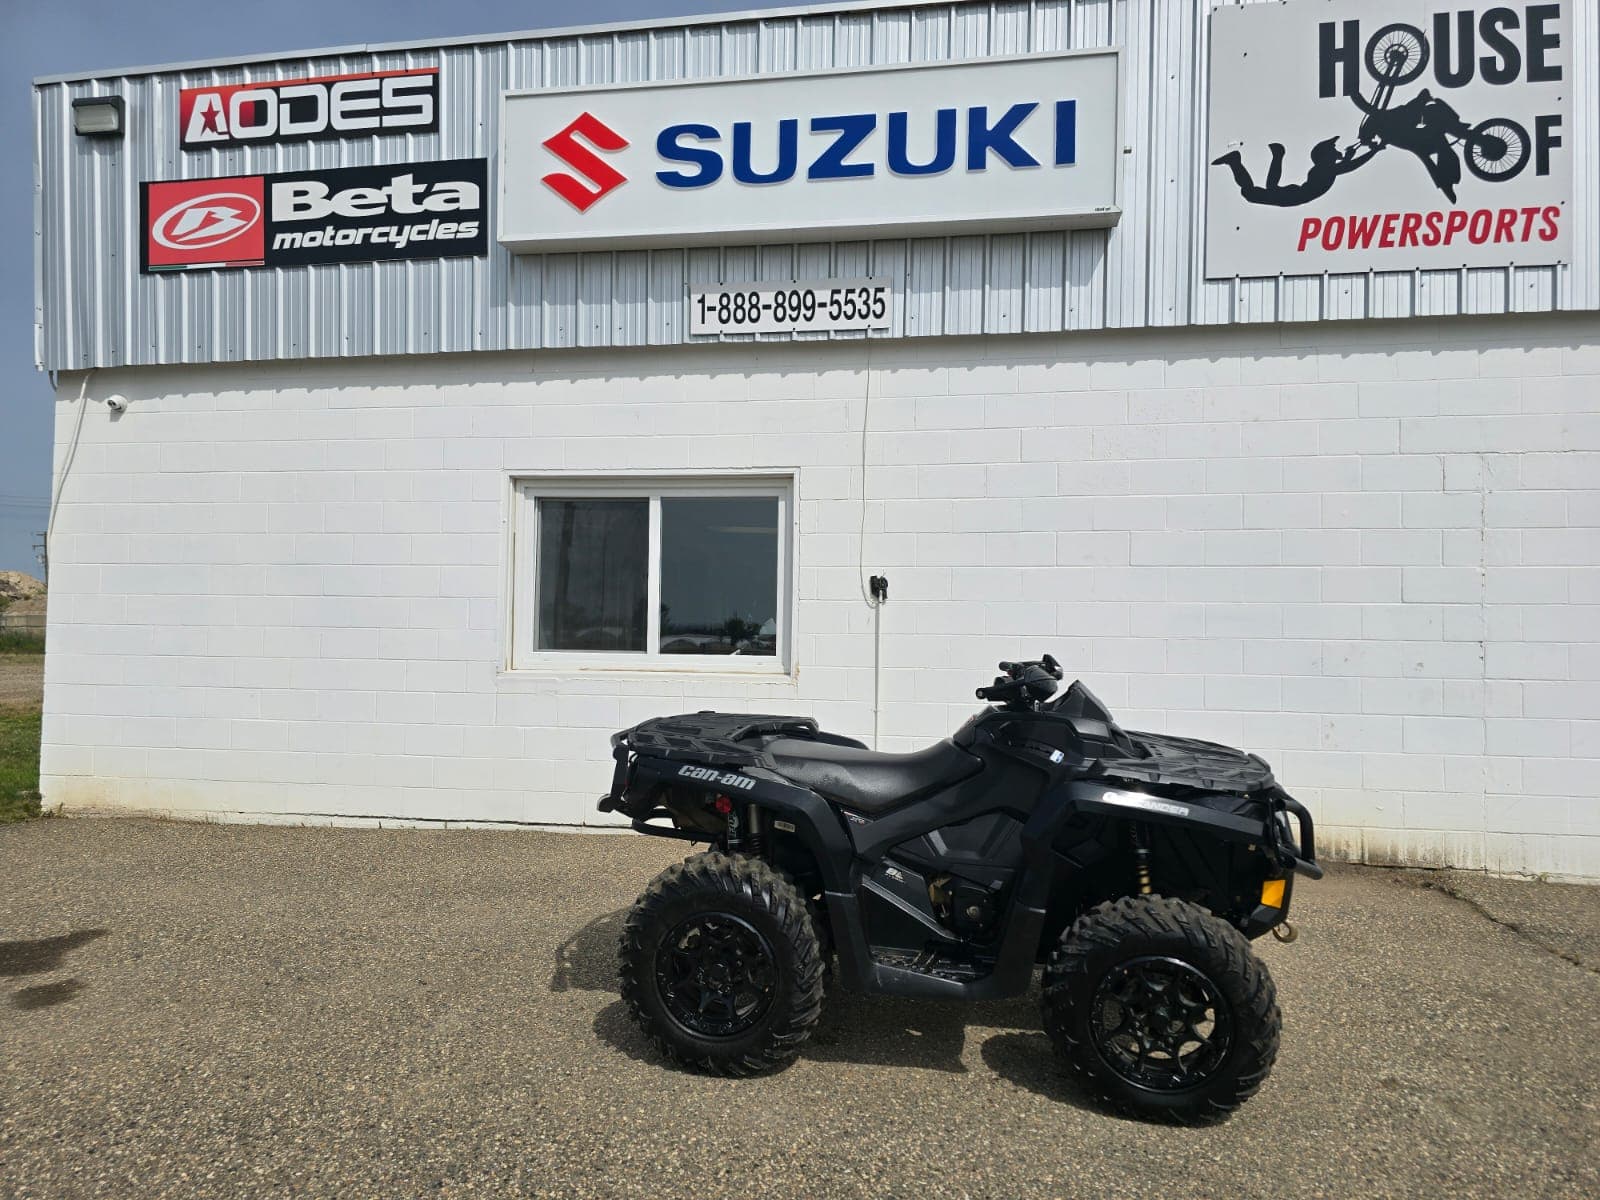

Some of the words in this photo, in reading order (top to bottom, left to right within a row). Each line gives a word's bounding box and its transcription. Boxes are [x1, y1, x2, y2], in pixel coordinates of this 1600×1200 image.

[1319, 4, 1562, 98] HOUSE
[185, 75, 434, 143] AODES
[655, 99, 1077, 191] SUZUKI
[1464, 114, 1562, 182] OF
[272, 173, 480, 222] Beta
[272, 218, 480, 250] motorcycles
[1297, 206, 1561, 252] POWERSPORTS
[697, 287, 886, 324] 1-888-899-5535
[678, 765, 757, 790] can-am
[1102, 792, 1189, 816] OANDER
